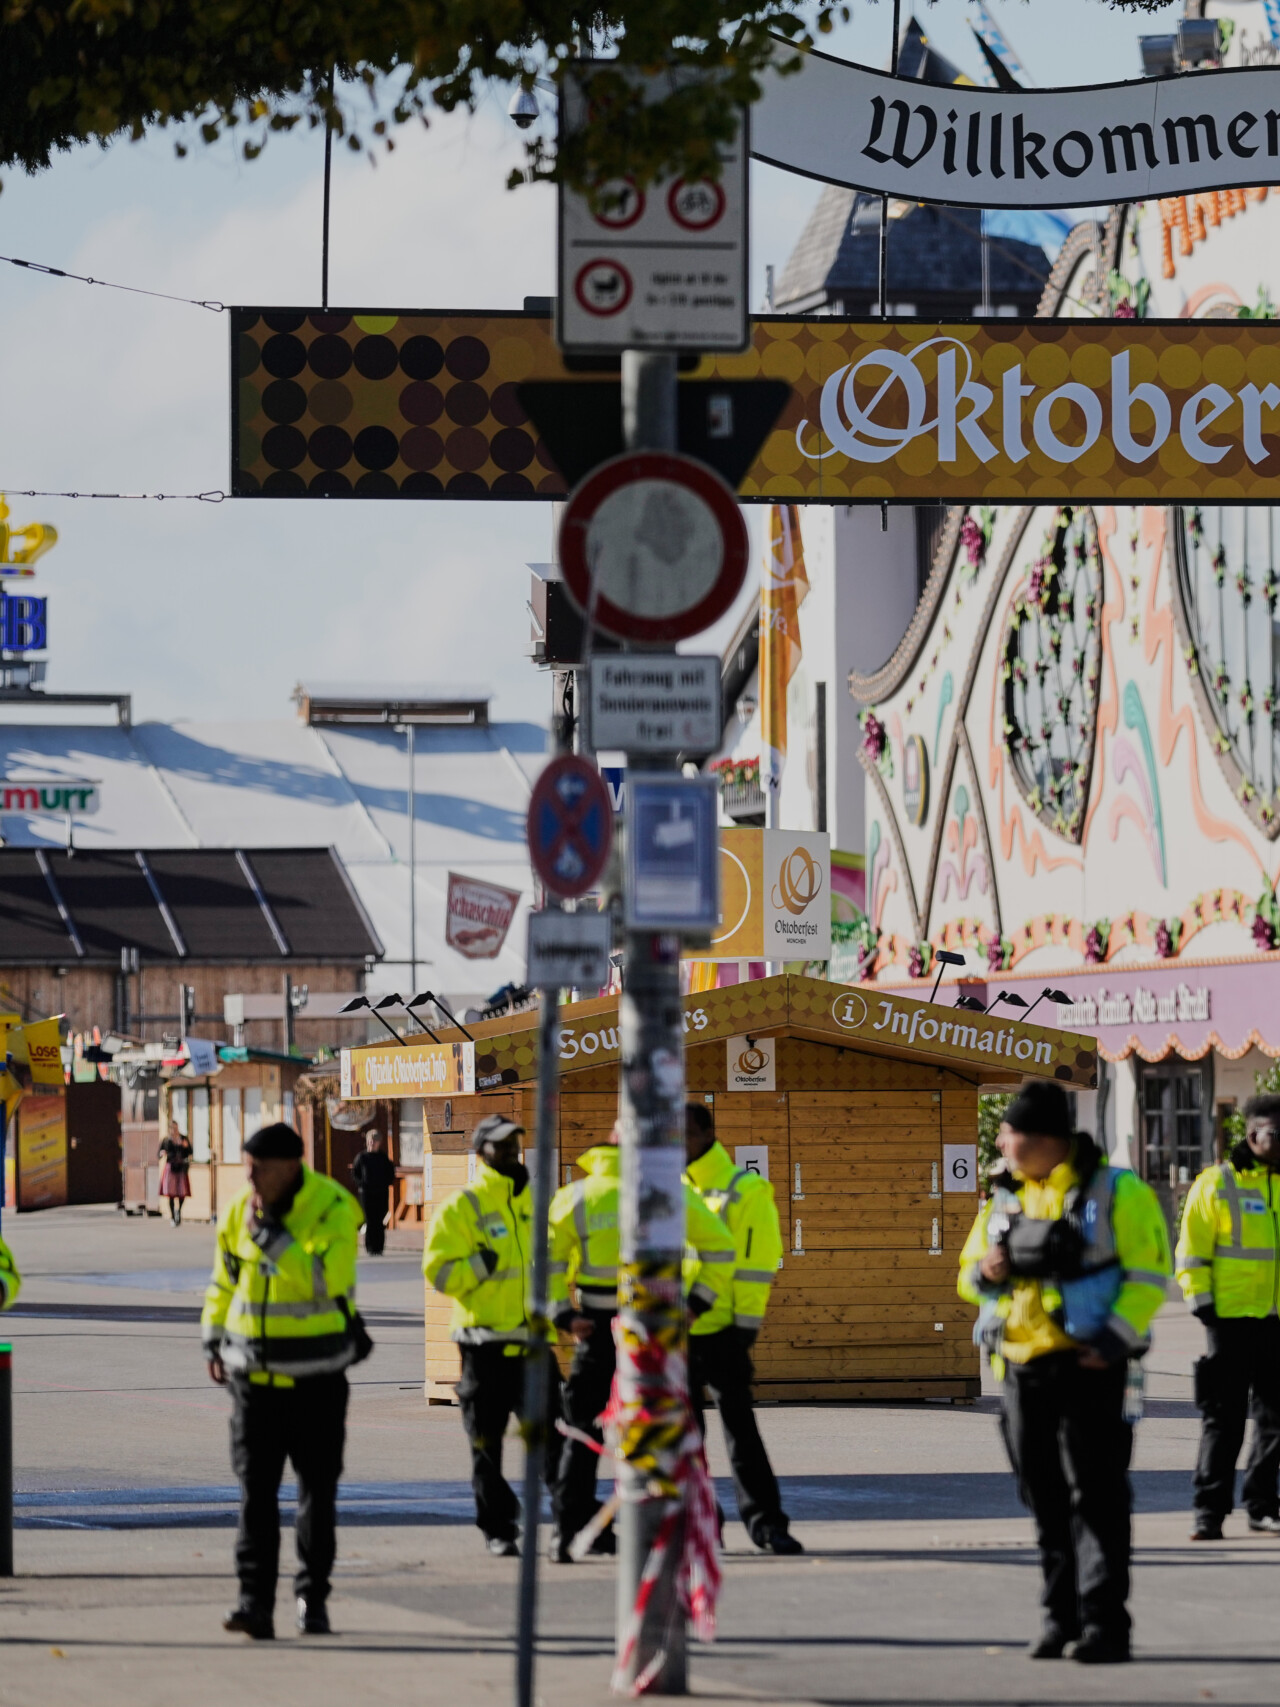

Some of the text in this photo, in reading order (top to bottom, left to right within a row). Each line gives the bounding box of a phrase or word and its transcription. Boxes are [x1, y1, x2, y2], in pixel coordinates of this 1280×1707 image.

[0, 787, 94, 810] murr
[774, 919, 818, 937] Oktoberfest
[557, 1008, 708, 1060] Sours
[872, 1000, 1052, 1065] Information
[28, 1042, 59, 1059] Lose
[394, 1053, 430, 1089] Oktoberfest
[952, 1158, 968, 1180] 6
